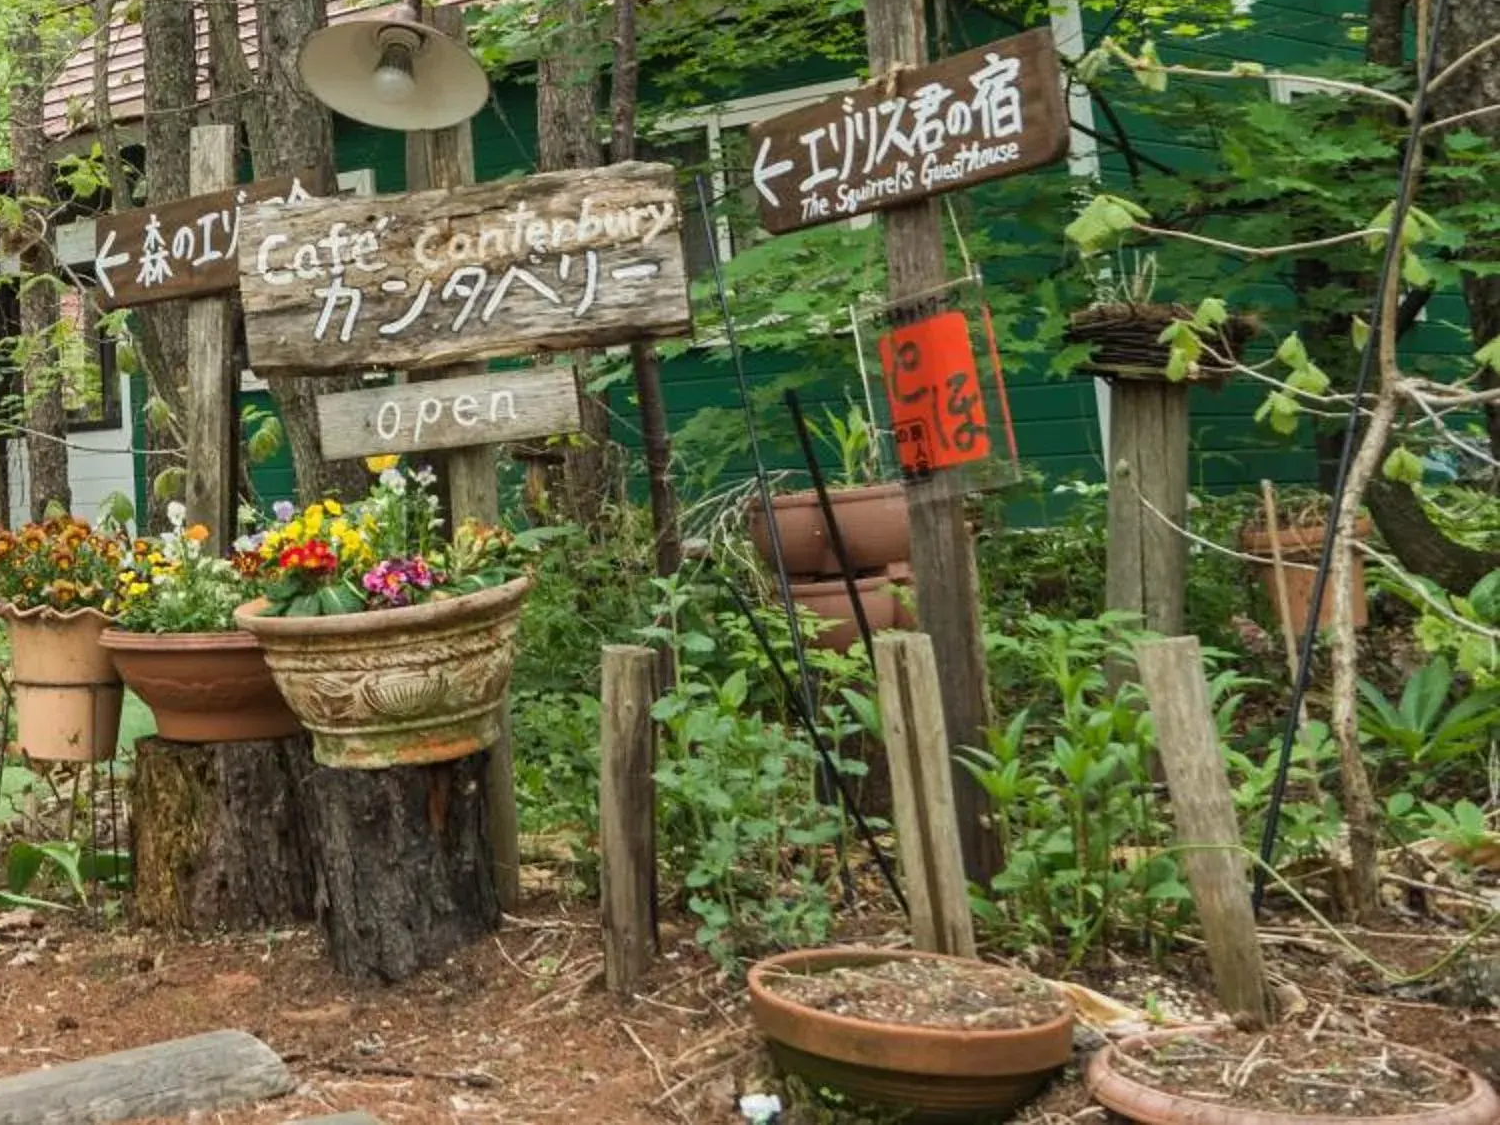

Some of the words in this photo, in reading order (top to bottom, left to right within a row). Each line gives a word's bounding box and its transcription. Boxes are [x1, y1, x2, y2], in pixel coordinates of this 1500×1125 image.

[799, 52, 1023, 192] エゾリス君の宿
[800, 191, 830, 222] The
[835, 160, 913, 214] Squirrel's
[415, 197, 675, 271] Canterbury
[313, 248, 661, 343] カンタベリー
